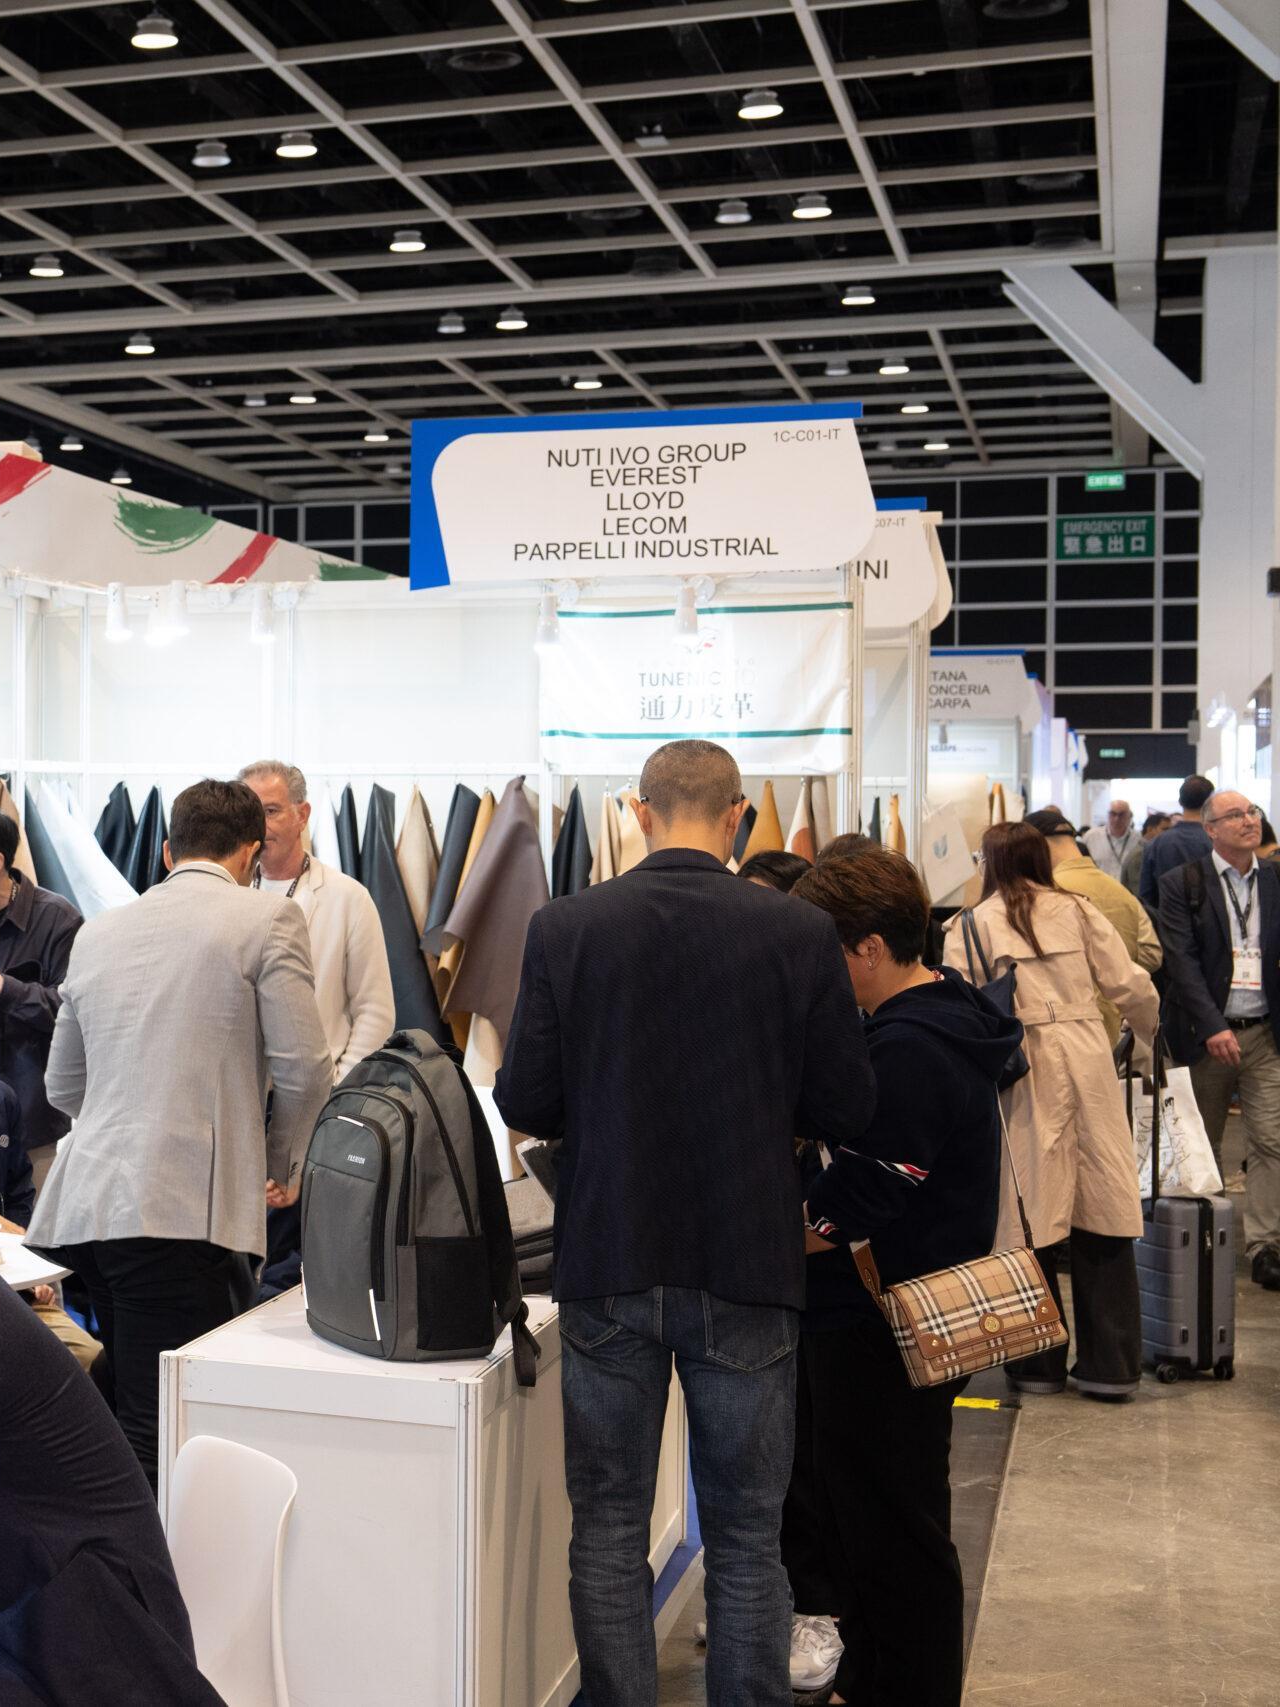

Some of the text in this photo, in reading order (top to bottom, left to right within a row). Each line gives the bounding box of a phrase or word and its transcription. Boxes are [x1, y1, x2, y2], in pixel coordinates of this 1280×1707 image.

[773, 428, 841, 443] 1C-C01-IT
[547, 442, 747, 468] NUTI IVO GROUP
[590, 465, 703, 487] EVEREST
[606, 491, 685, 511] LLOYD
[603, 516, 687, 536] LECOM
[1063, 519, 1147, 534] EMERGENCY EXIT
[513, 537, 779, 561] PARPELLI INDUSTRIAL
[856, 559, 888, 579] INI
[928, 684, 991, 696] ONCERIA
